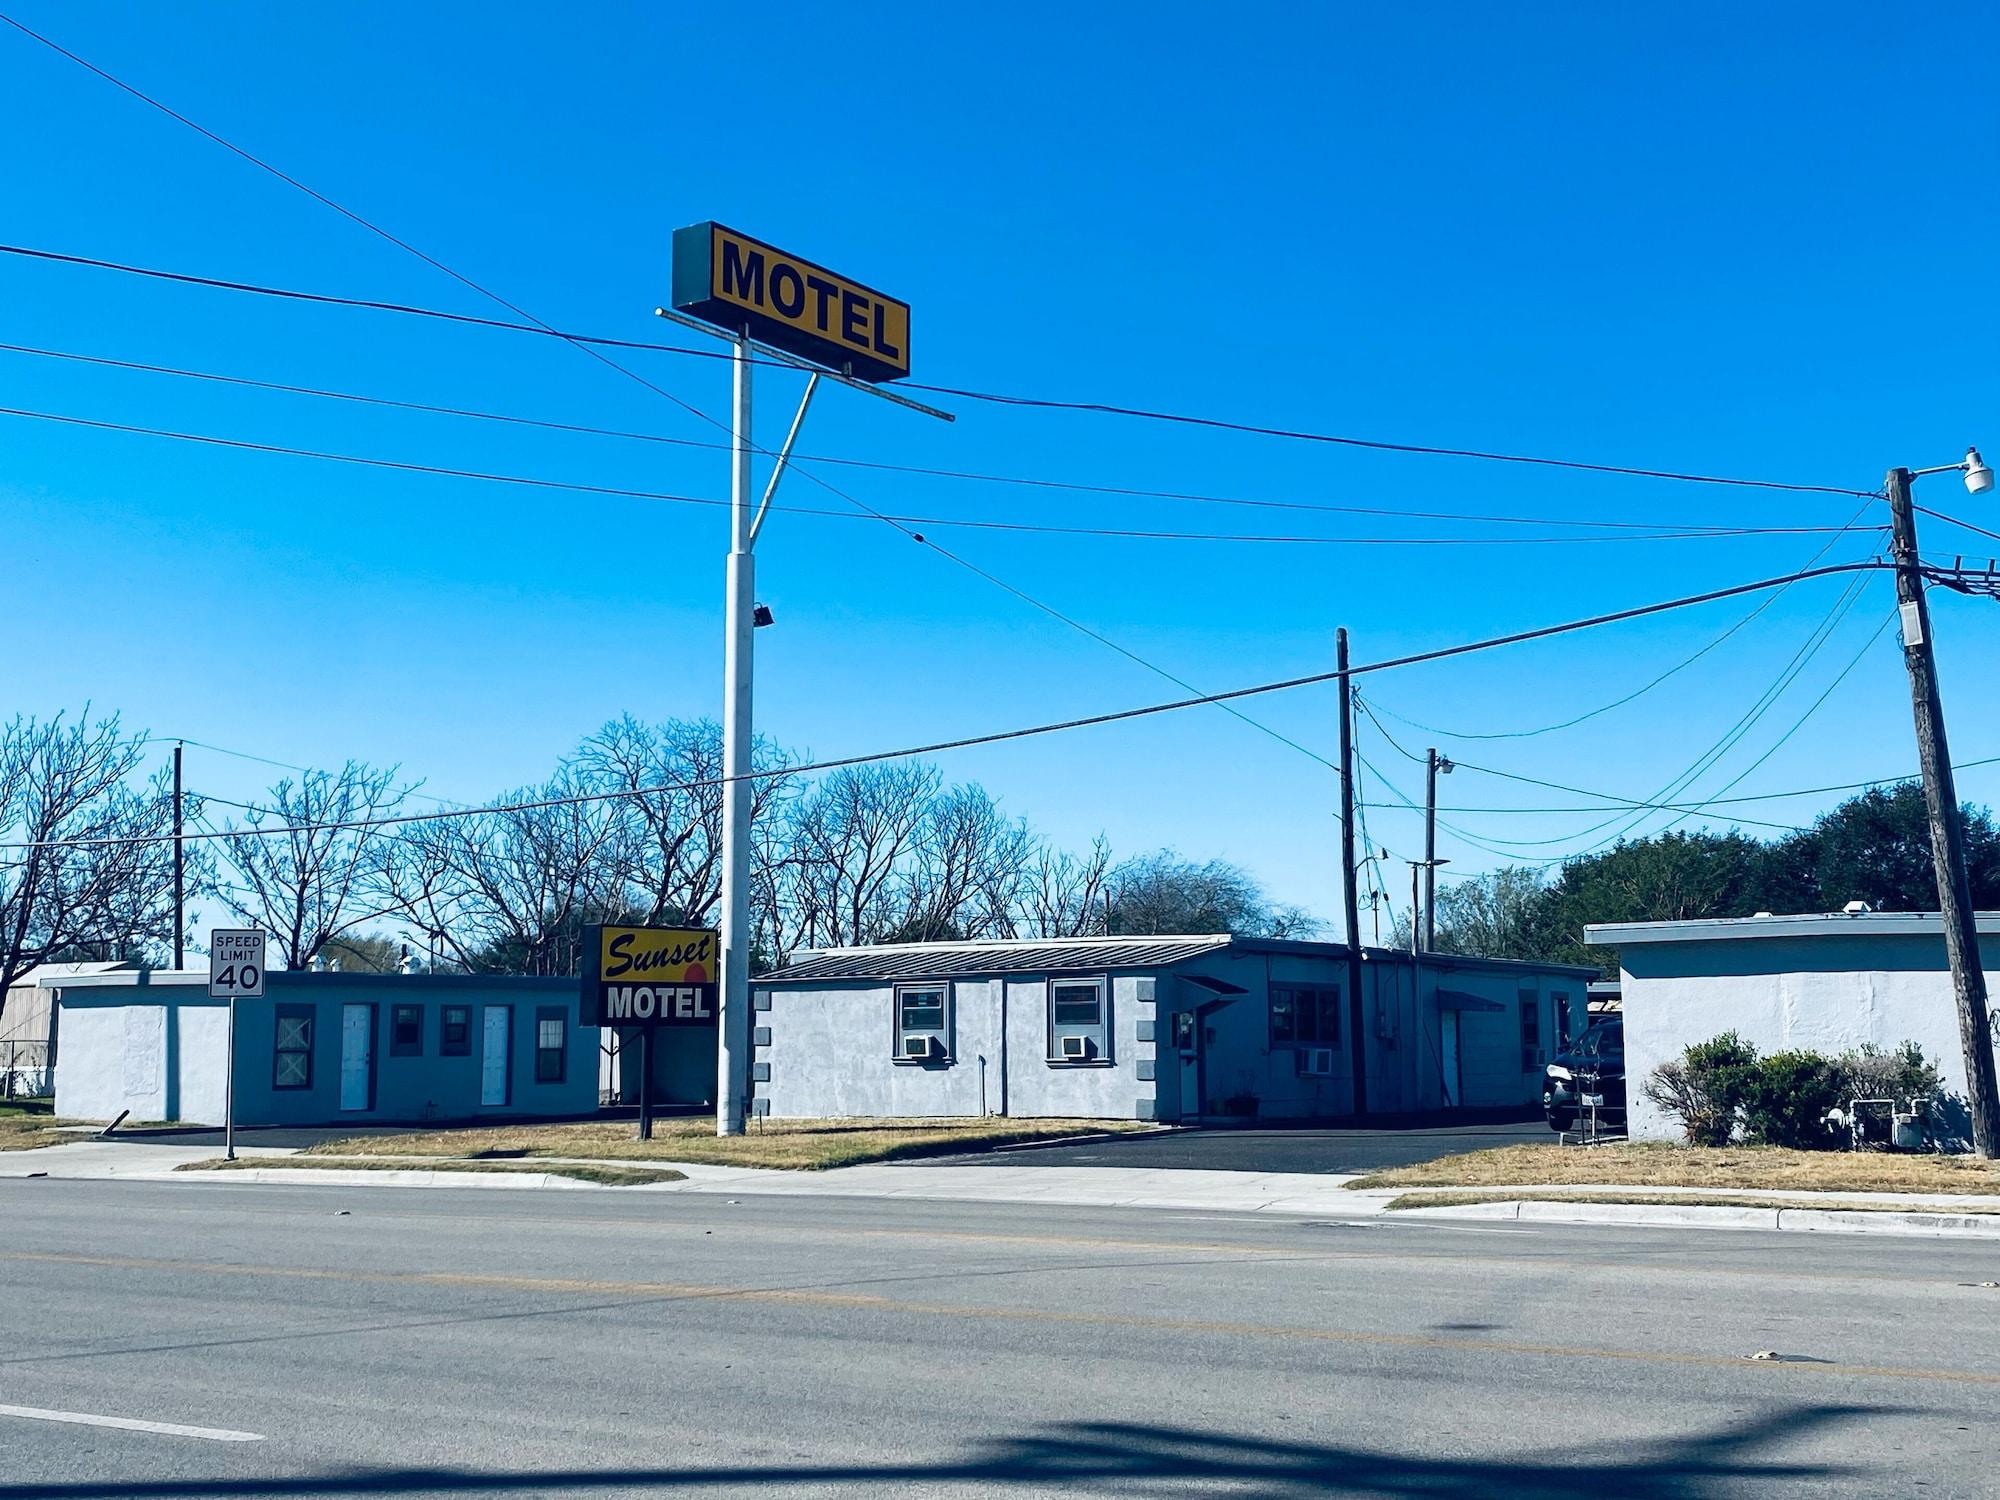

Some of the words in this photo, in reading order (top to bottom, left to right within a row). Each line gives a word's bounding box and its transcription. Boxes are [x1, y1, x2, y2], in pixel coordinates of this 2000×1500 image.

[722, 239, 899, 361] MOTEL
[216, 936, 261, 947] SPEED
[220, 950, 255, 961] LIMIT
[605, 933, 711, 977] Sunset
[215, 965, 259, 989] 40
[607, 986, 711, 1019] MOTEL
